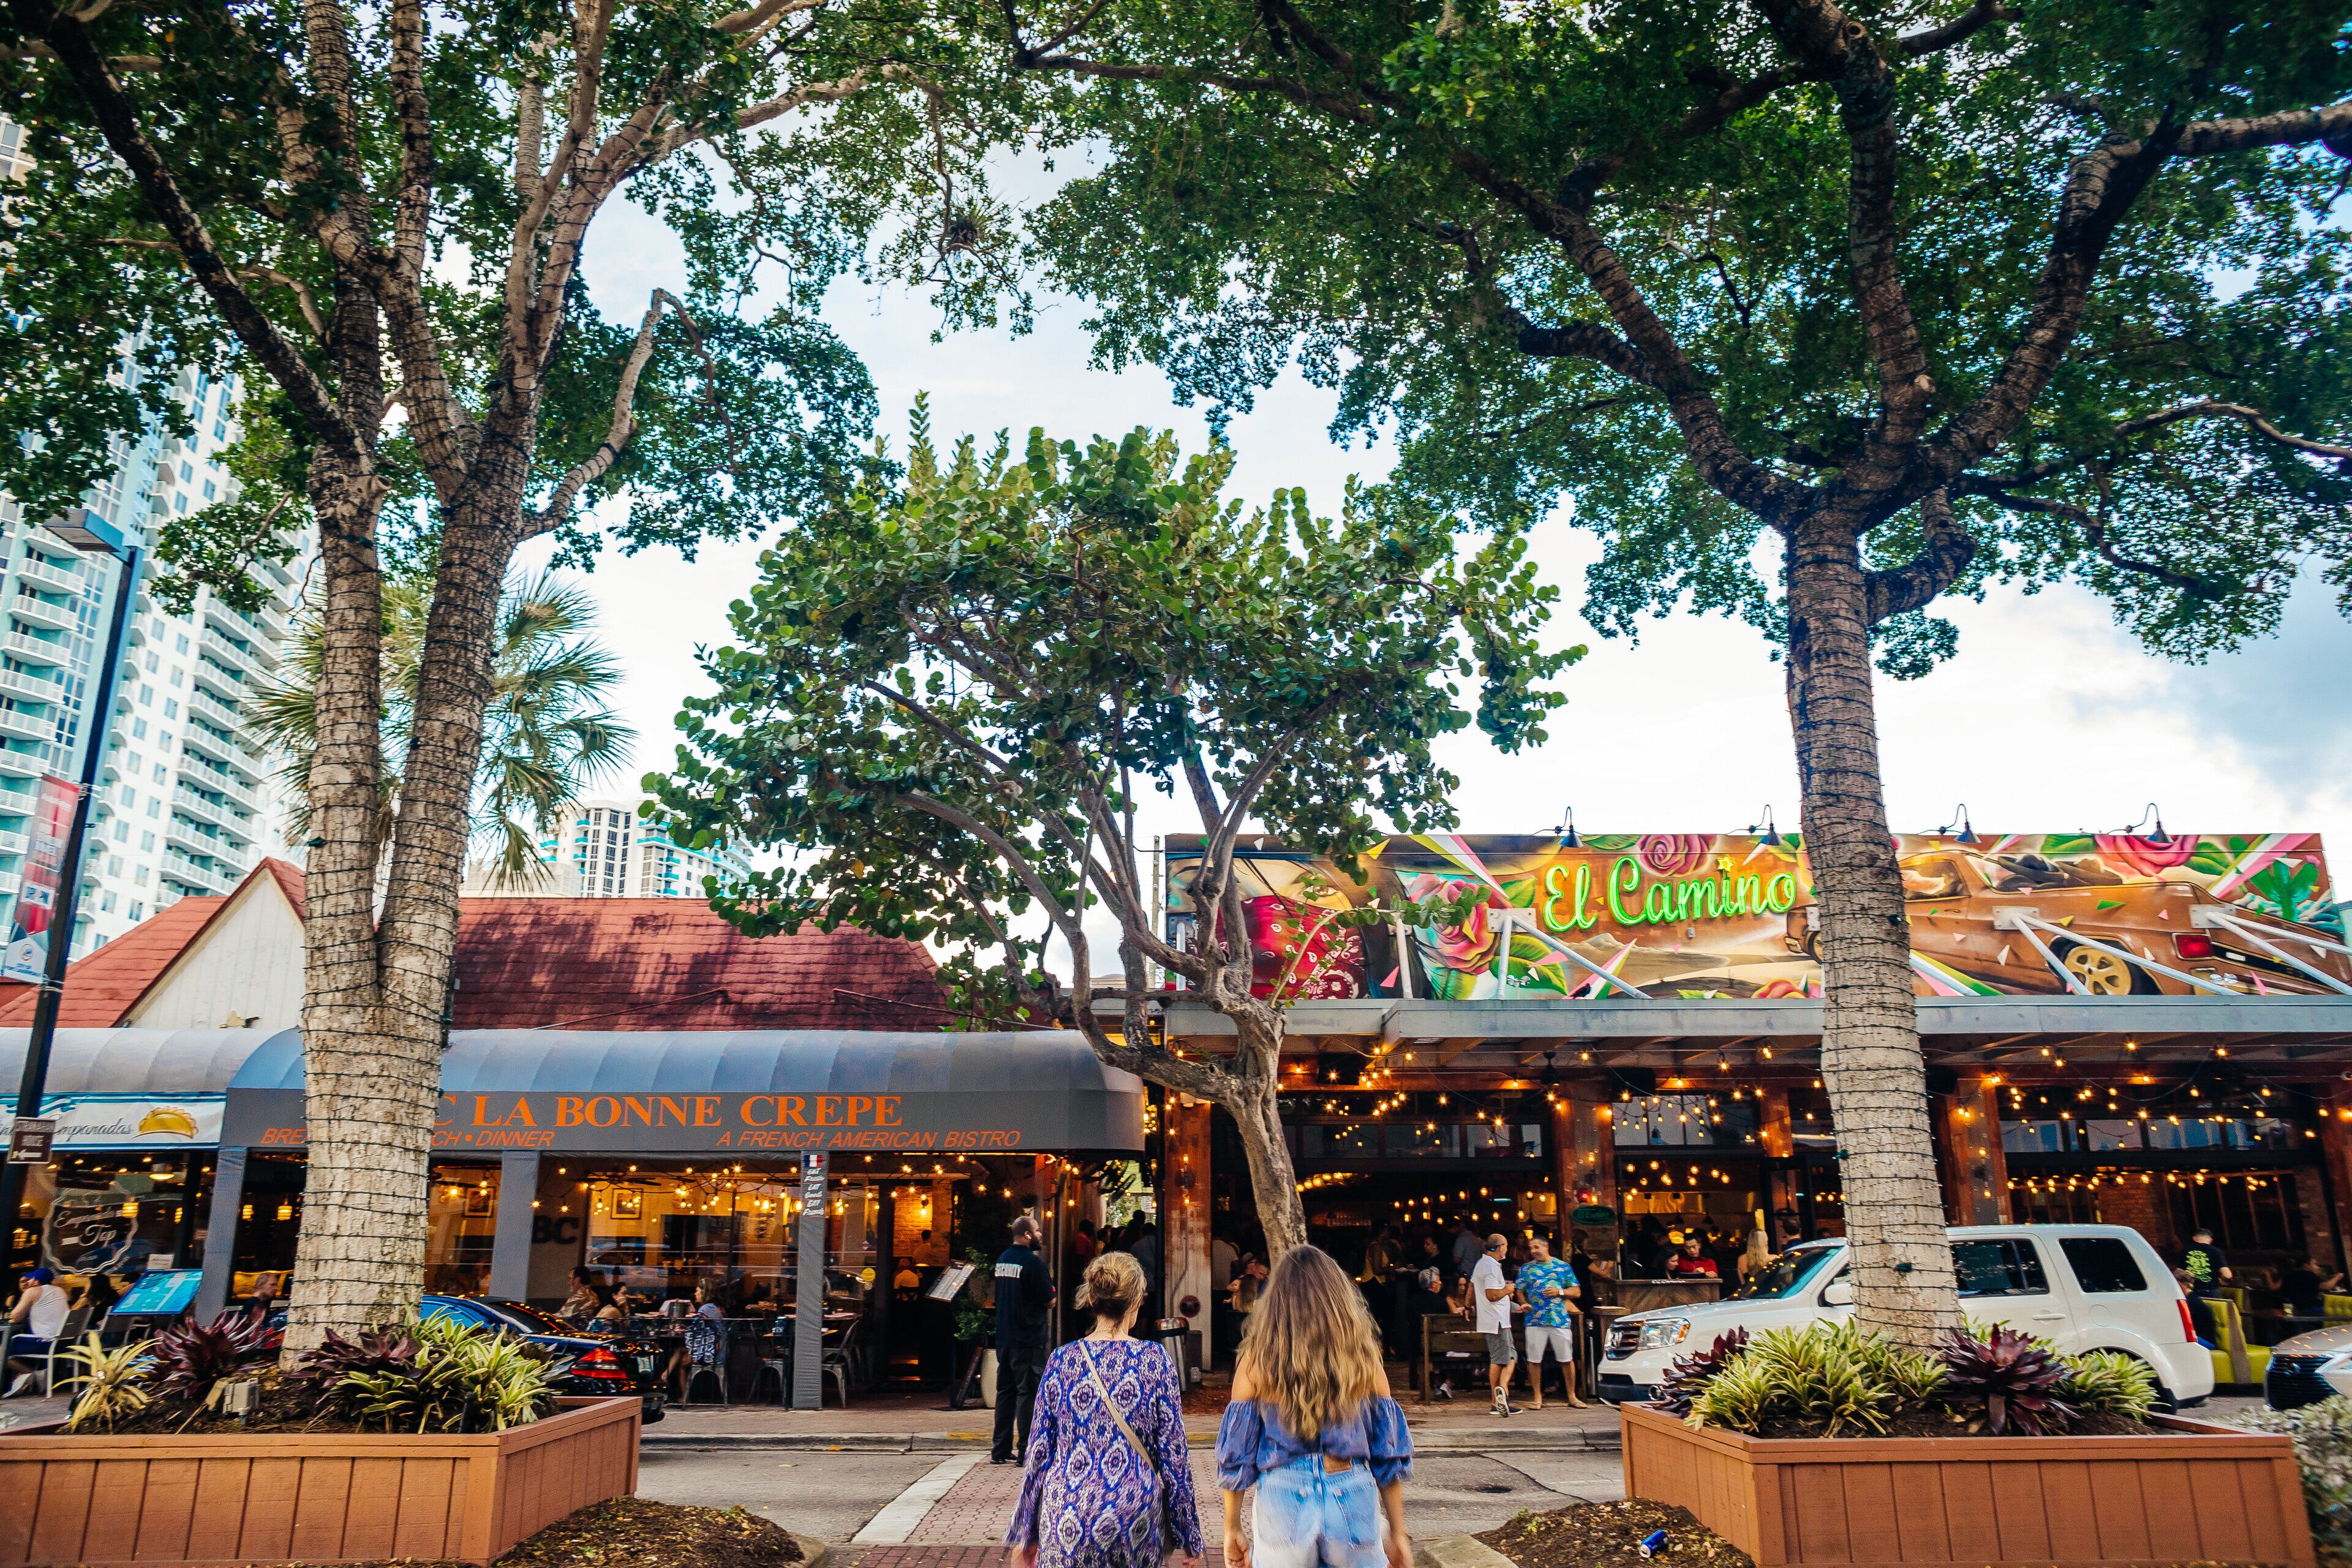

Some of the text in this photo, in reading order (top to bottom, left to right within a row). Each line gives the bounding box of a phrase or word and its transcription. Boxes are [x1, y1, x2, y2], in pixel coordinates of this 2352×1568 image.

[1543, 854, 1796, 932] El Camino
[471, 1096, 538, 1126] LA
[552, 1096, 723, 1127] BONNE
[740, 1095, 903, 1126] CREPE
[49, 1114, 133, 1142] mpanadas
[475, 1130, 556, 1147] DINNER
[717, 1129, 1021, 1147] A FRENCH AMERICAN BISTRO
